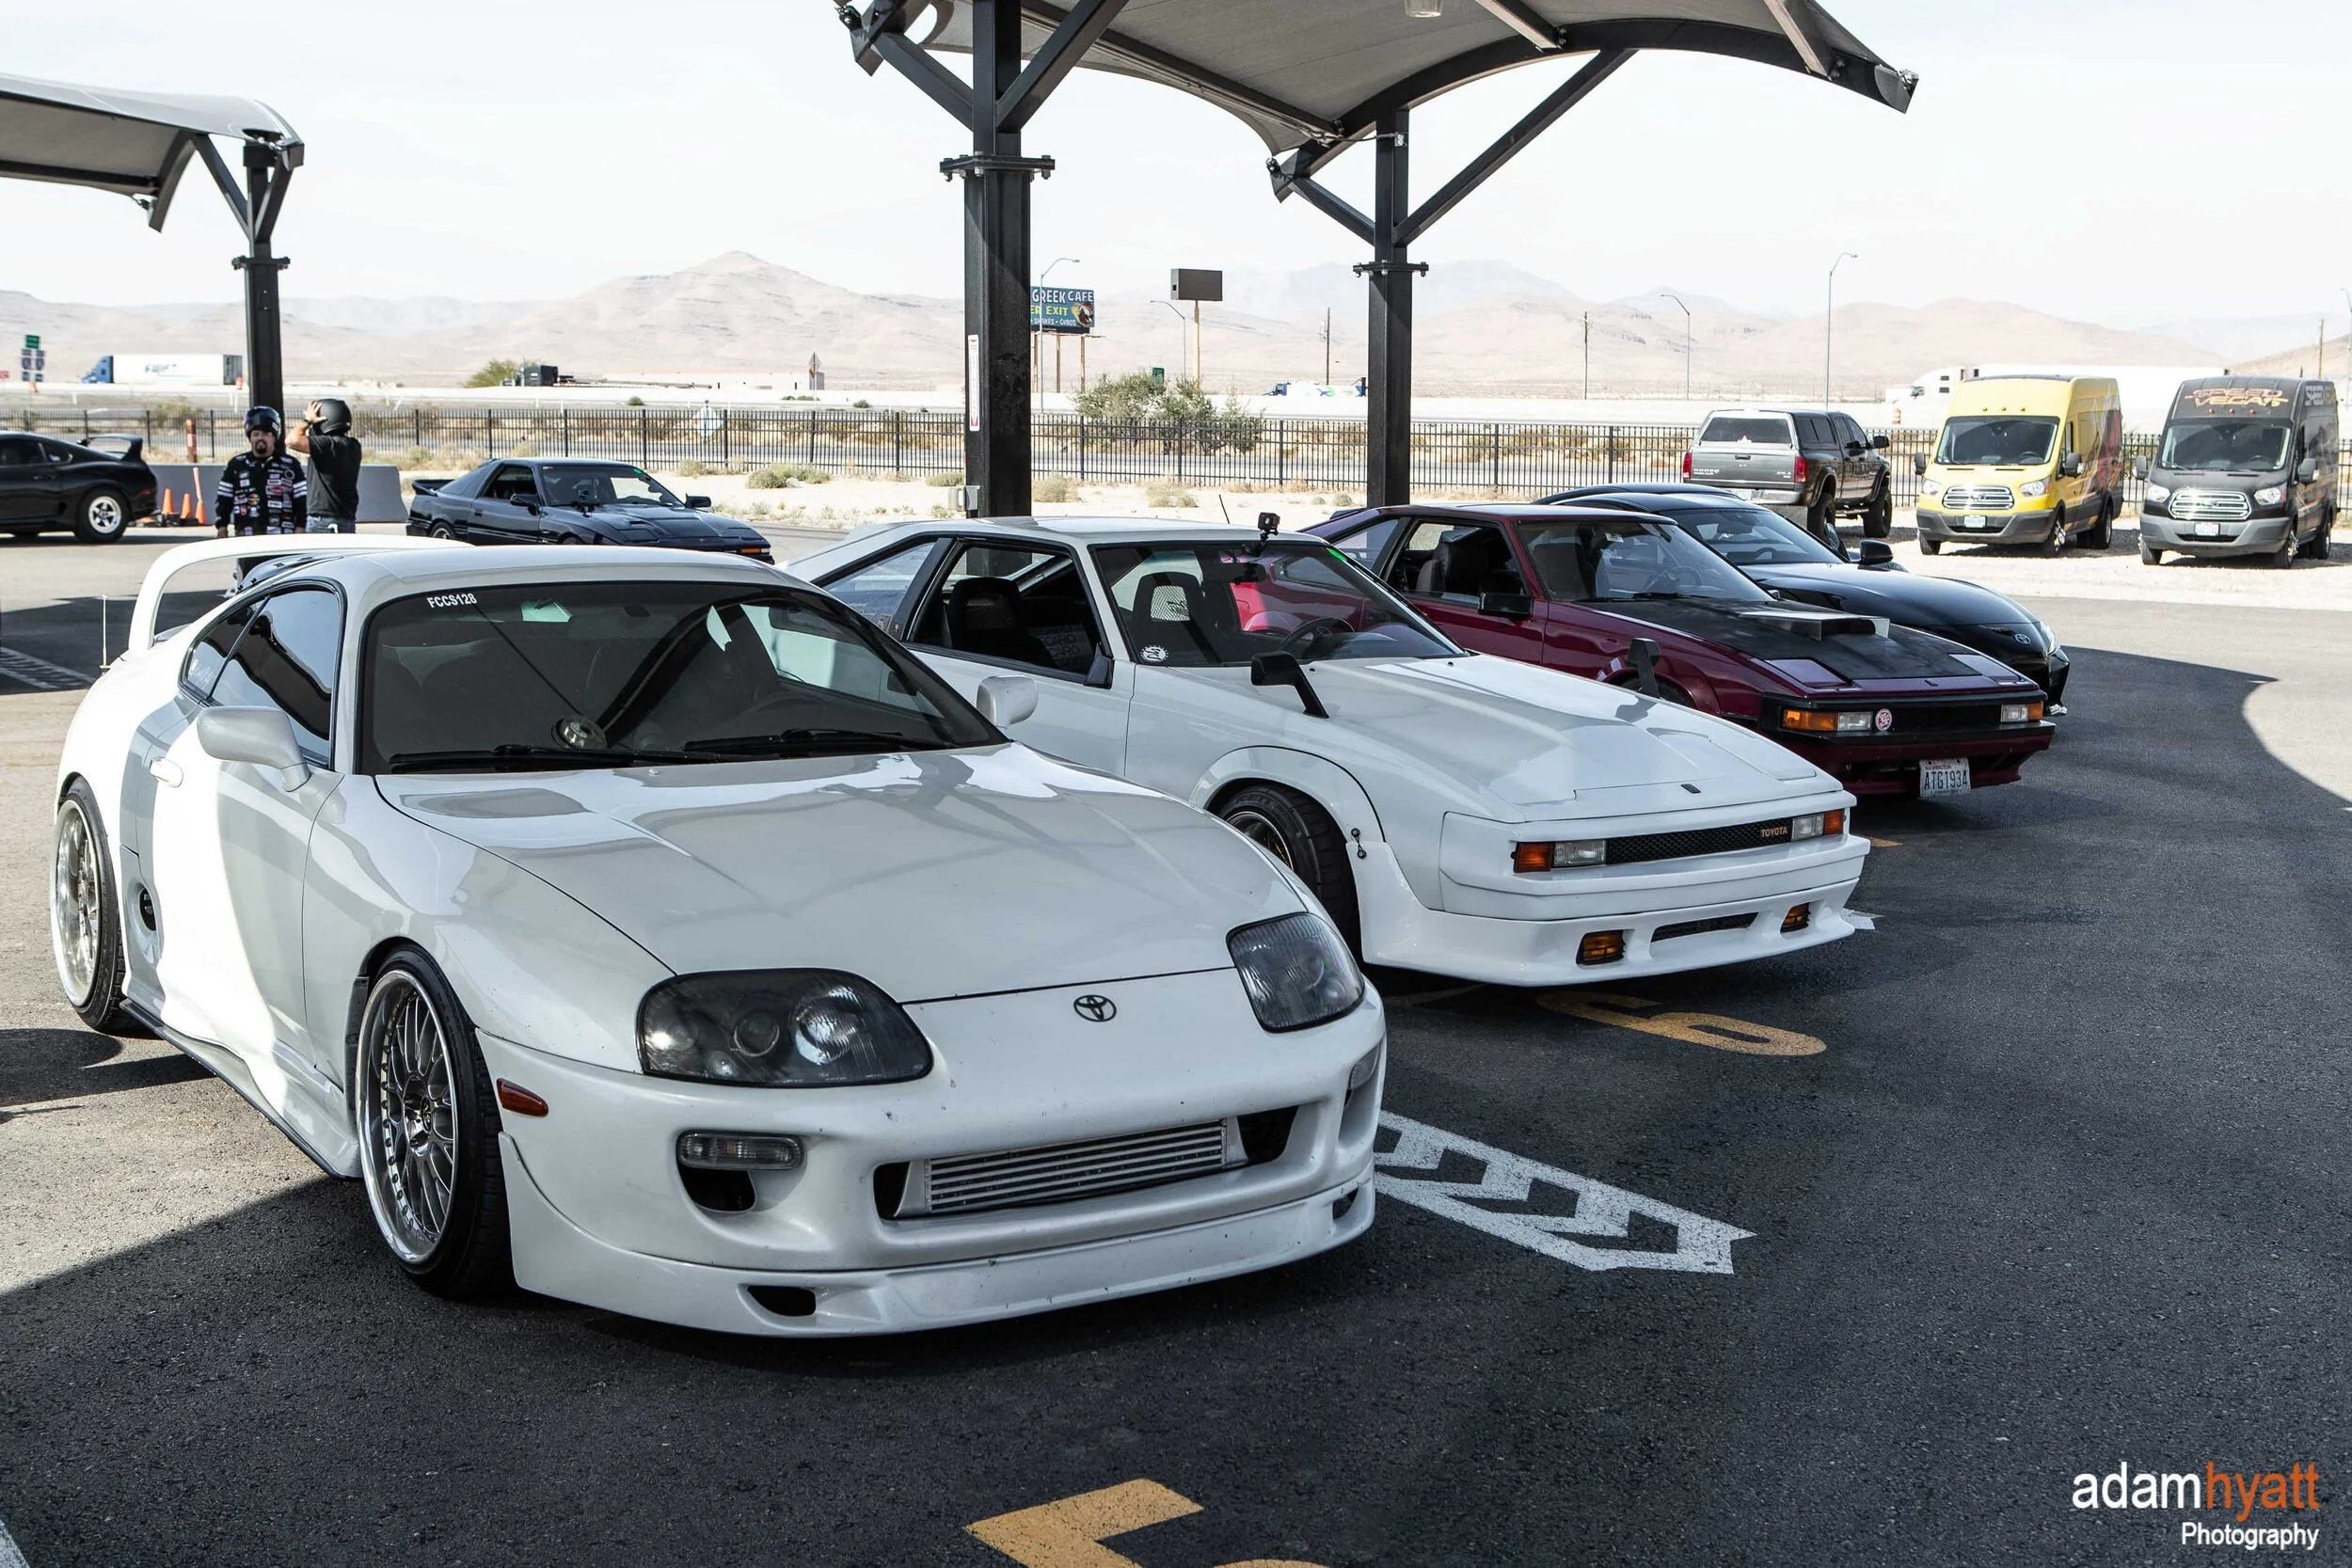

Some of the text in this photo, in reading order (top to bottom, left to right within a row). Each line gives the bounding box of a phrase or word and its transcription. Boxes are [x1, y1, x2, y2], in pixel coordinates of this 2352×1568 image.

[1032, 289, 1094, 303] GREEK CAFE
[1046, 306, 1069, 316] EXIT
[2185, 388, 2284, 399] SPEED
[2194, 396, 2289, 407] VEGAS
[426, 593, 478, 609] FCCS128
[1924, 769, 1968, 790] ATG1934
[1760, 826, 1788, 837] TOYOTA
